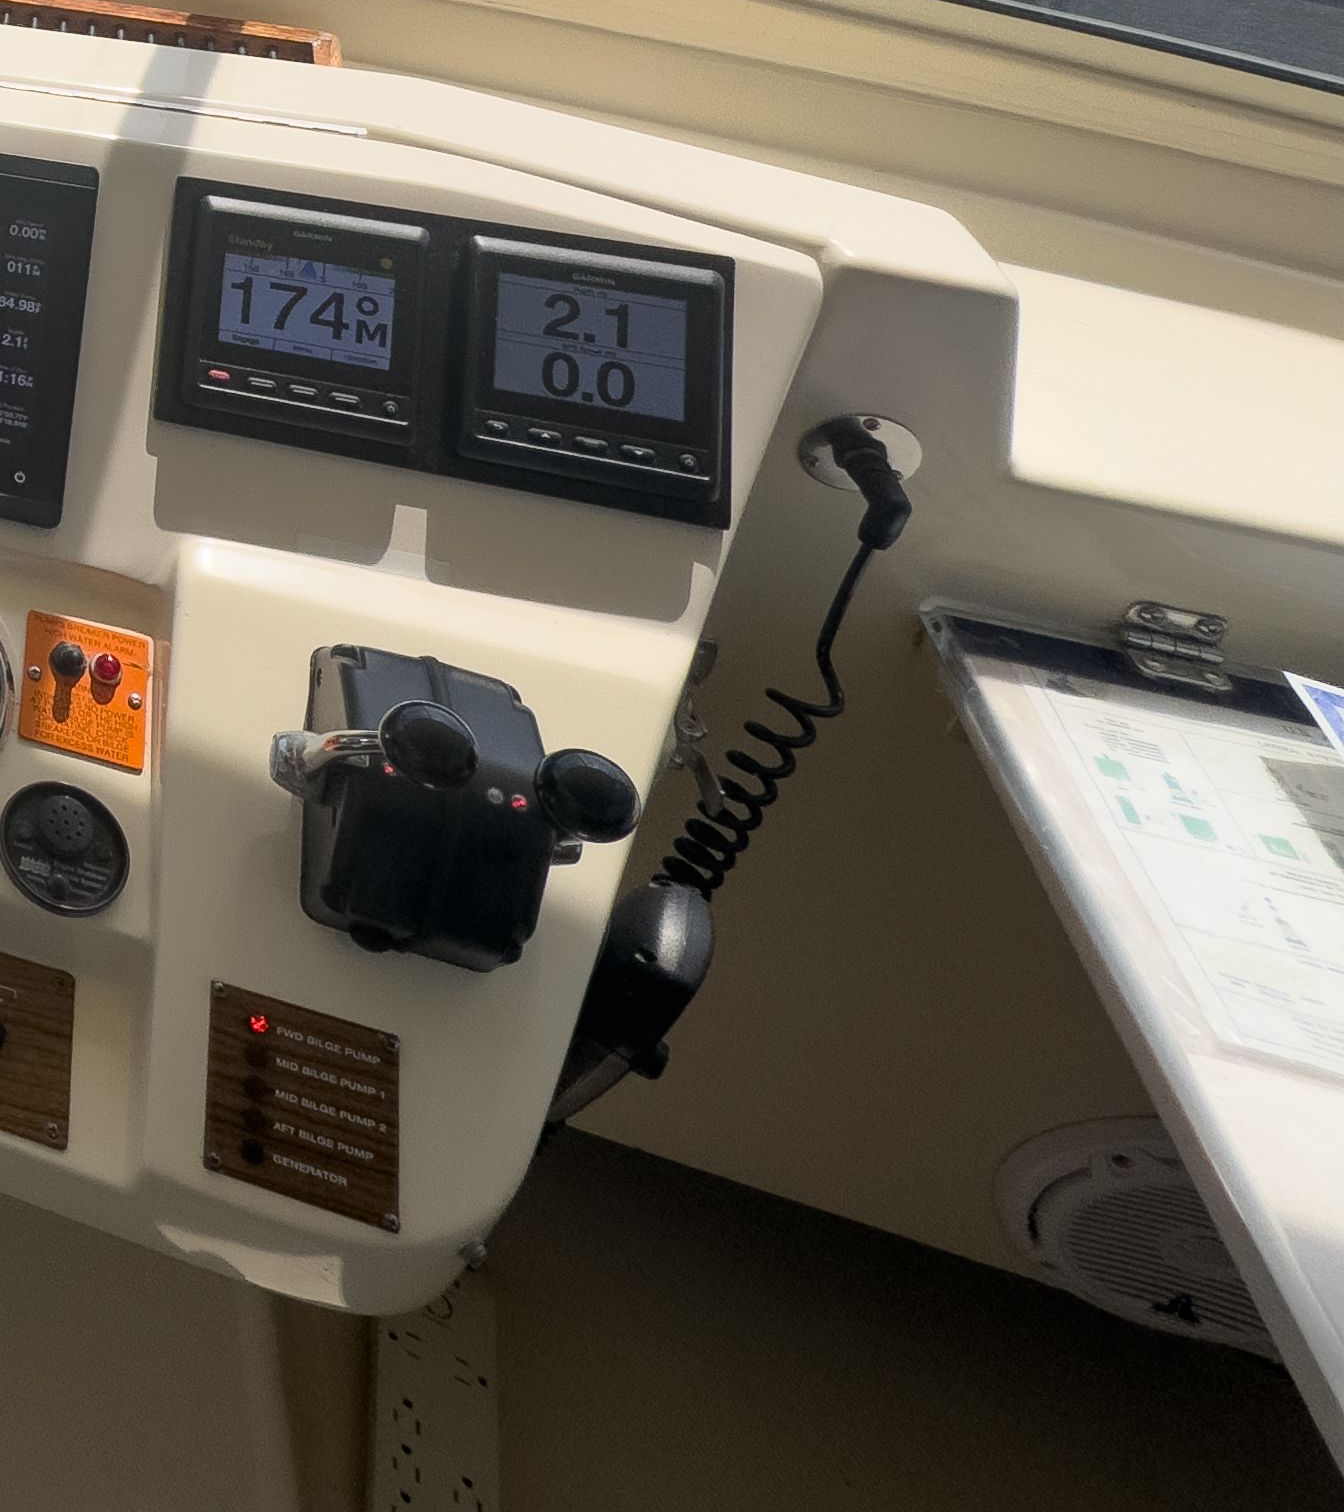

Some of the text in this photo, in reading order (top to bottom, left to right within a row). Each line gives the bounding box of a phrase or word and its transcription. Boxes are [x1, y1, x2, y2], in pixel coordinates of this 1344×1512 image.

[543, 293, 629, 349] 2.1
[542, 351, 636, 407] 0.0
[67, 621, 110, 639] BREAKER
[112, 634, 146, 649] POWER
[69, 631, 134, 657] WATER ALARM
[56, 734, 94, 753] EXCESS
[95, 746, 129, 763] WATER
[276, 1026, 382, 1065] FWD BILGE PUMP
[275, 1056, 299, 1072] MID
[302, 1066, 337, 1085] BILGE
[340, 1077, 376, 1096] PUMP
[274, 1089, 387, 1133] MID BILGE PUMP 2
[273, 1122, 375, 1160] AFT BILGE PUMP
[272, 1154, 348, 1186] GENERATOR
